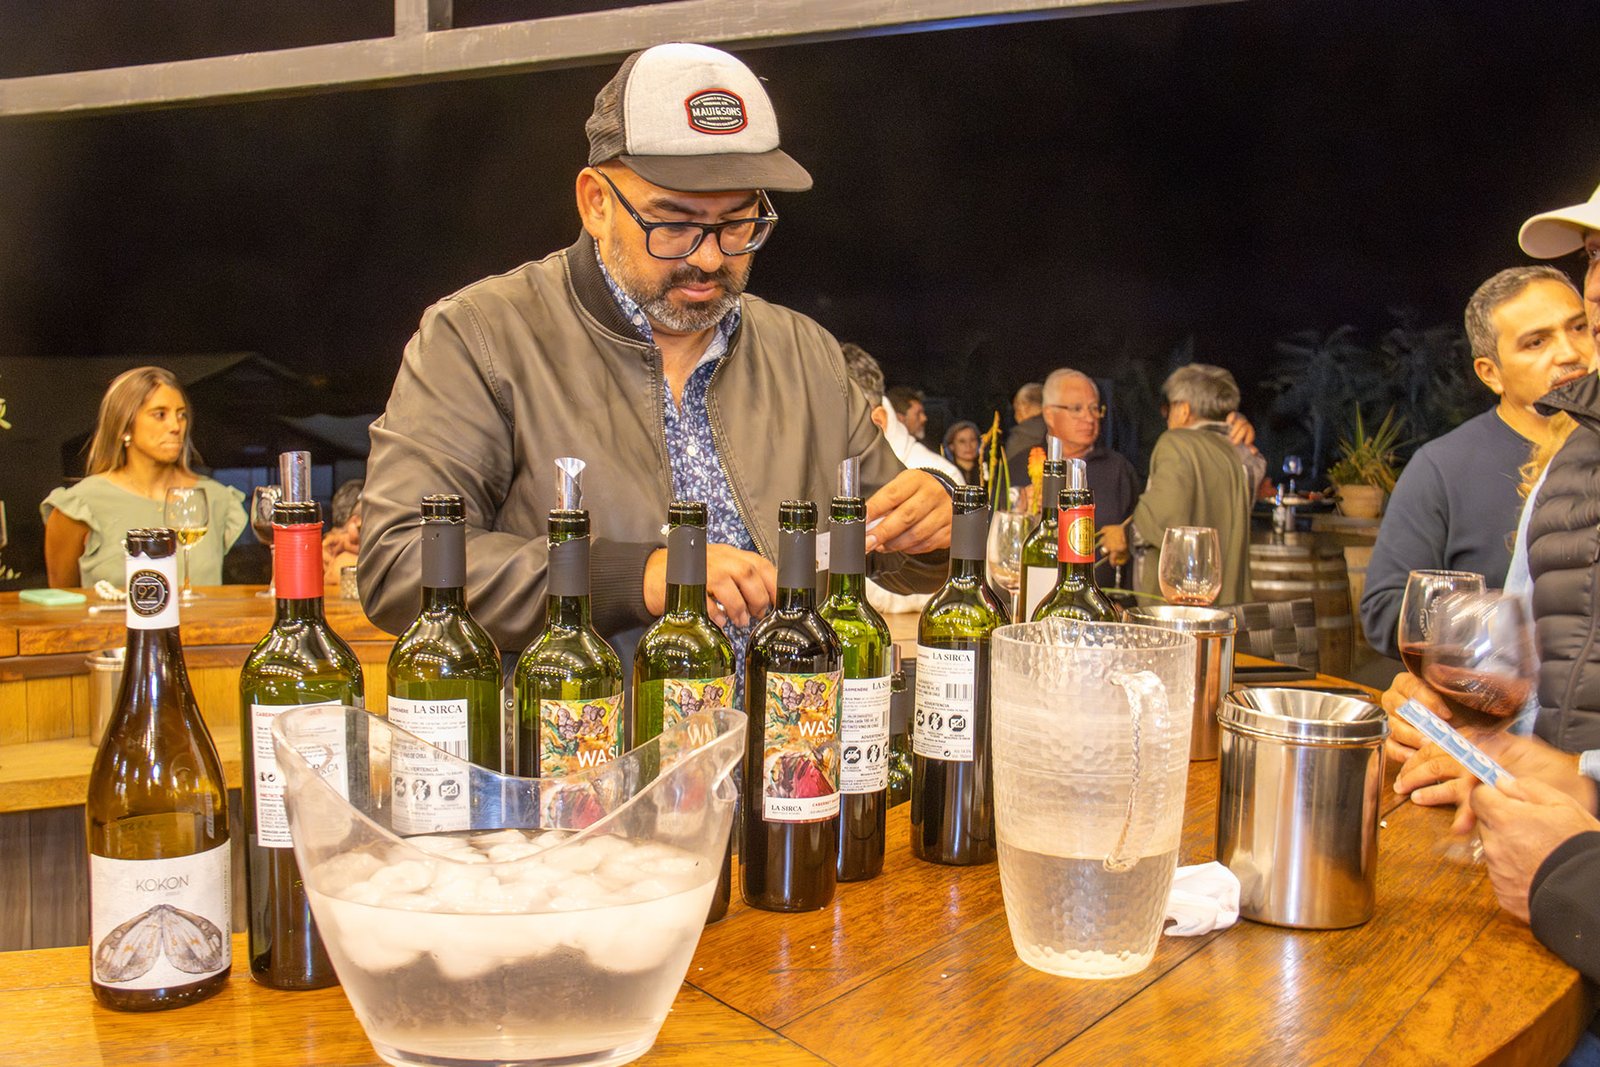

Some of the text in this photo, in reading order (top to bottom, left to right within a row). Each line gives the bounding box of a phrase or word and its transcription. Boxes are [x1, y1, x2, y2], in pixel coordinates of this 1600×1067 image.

[137, 585, 158, 600] 92
[932, 652, 942, 660] LA
[943, 653, 971, 662] SIRCA
[413, 704, 463, 714] LA SIRCA
[798, 718, 837, 737] WASI
[781, 804, 803, 812] SIRCA
[136, 874, 190, 893] KOKON
